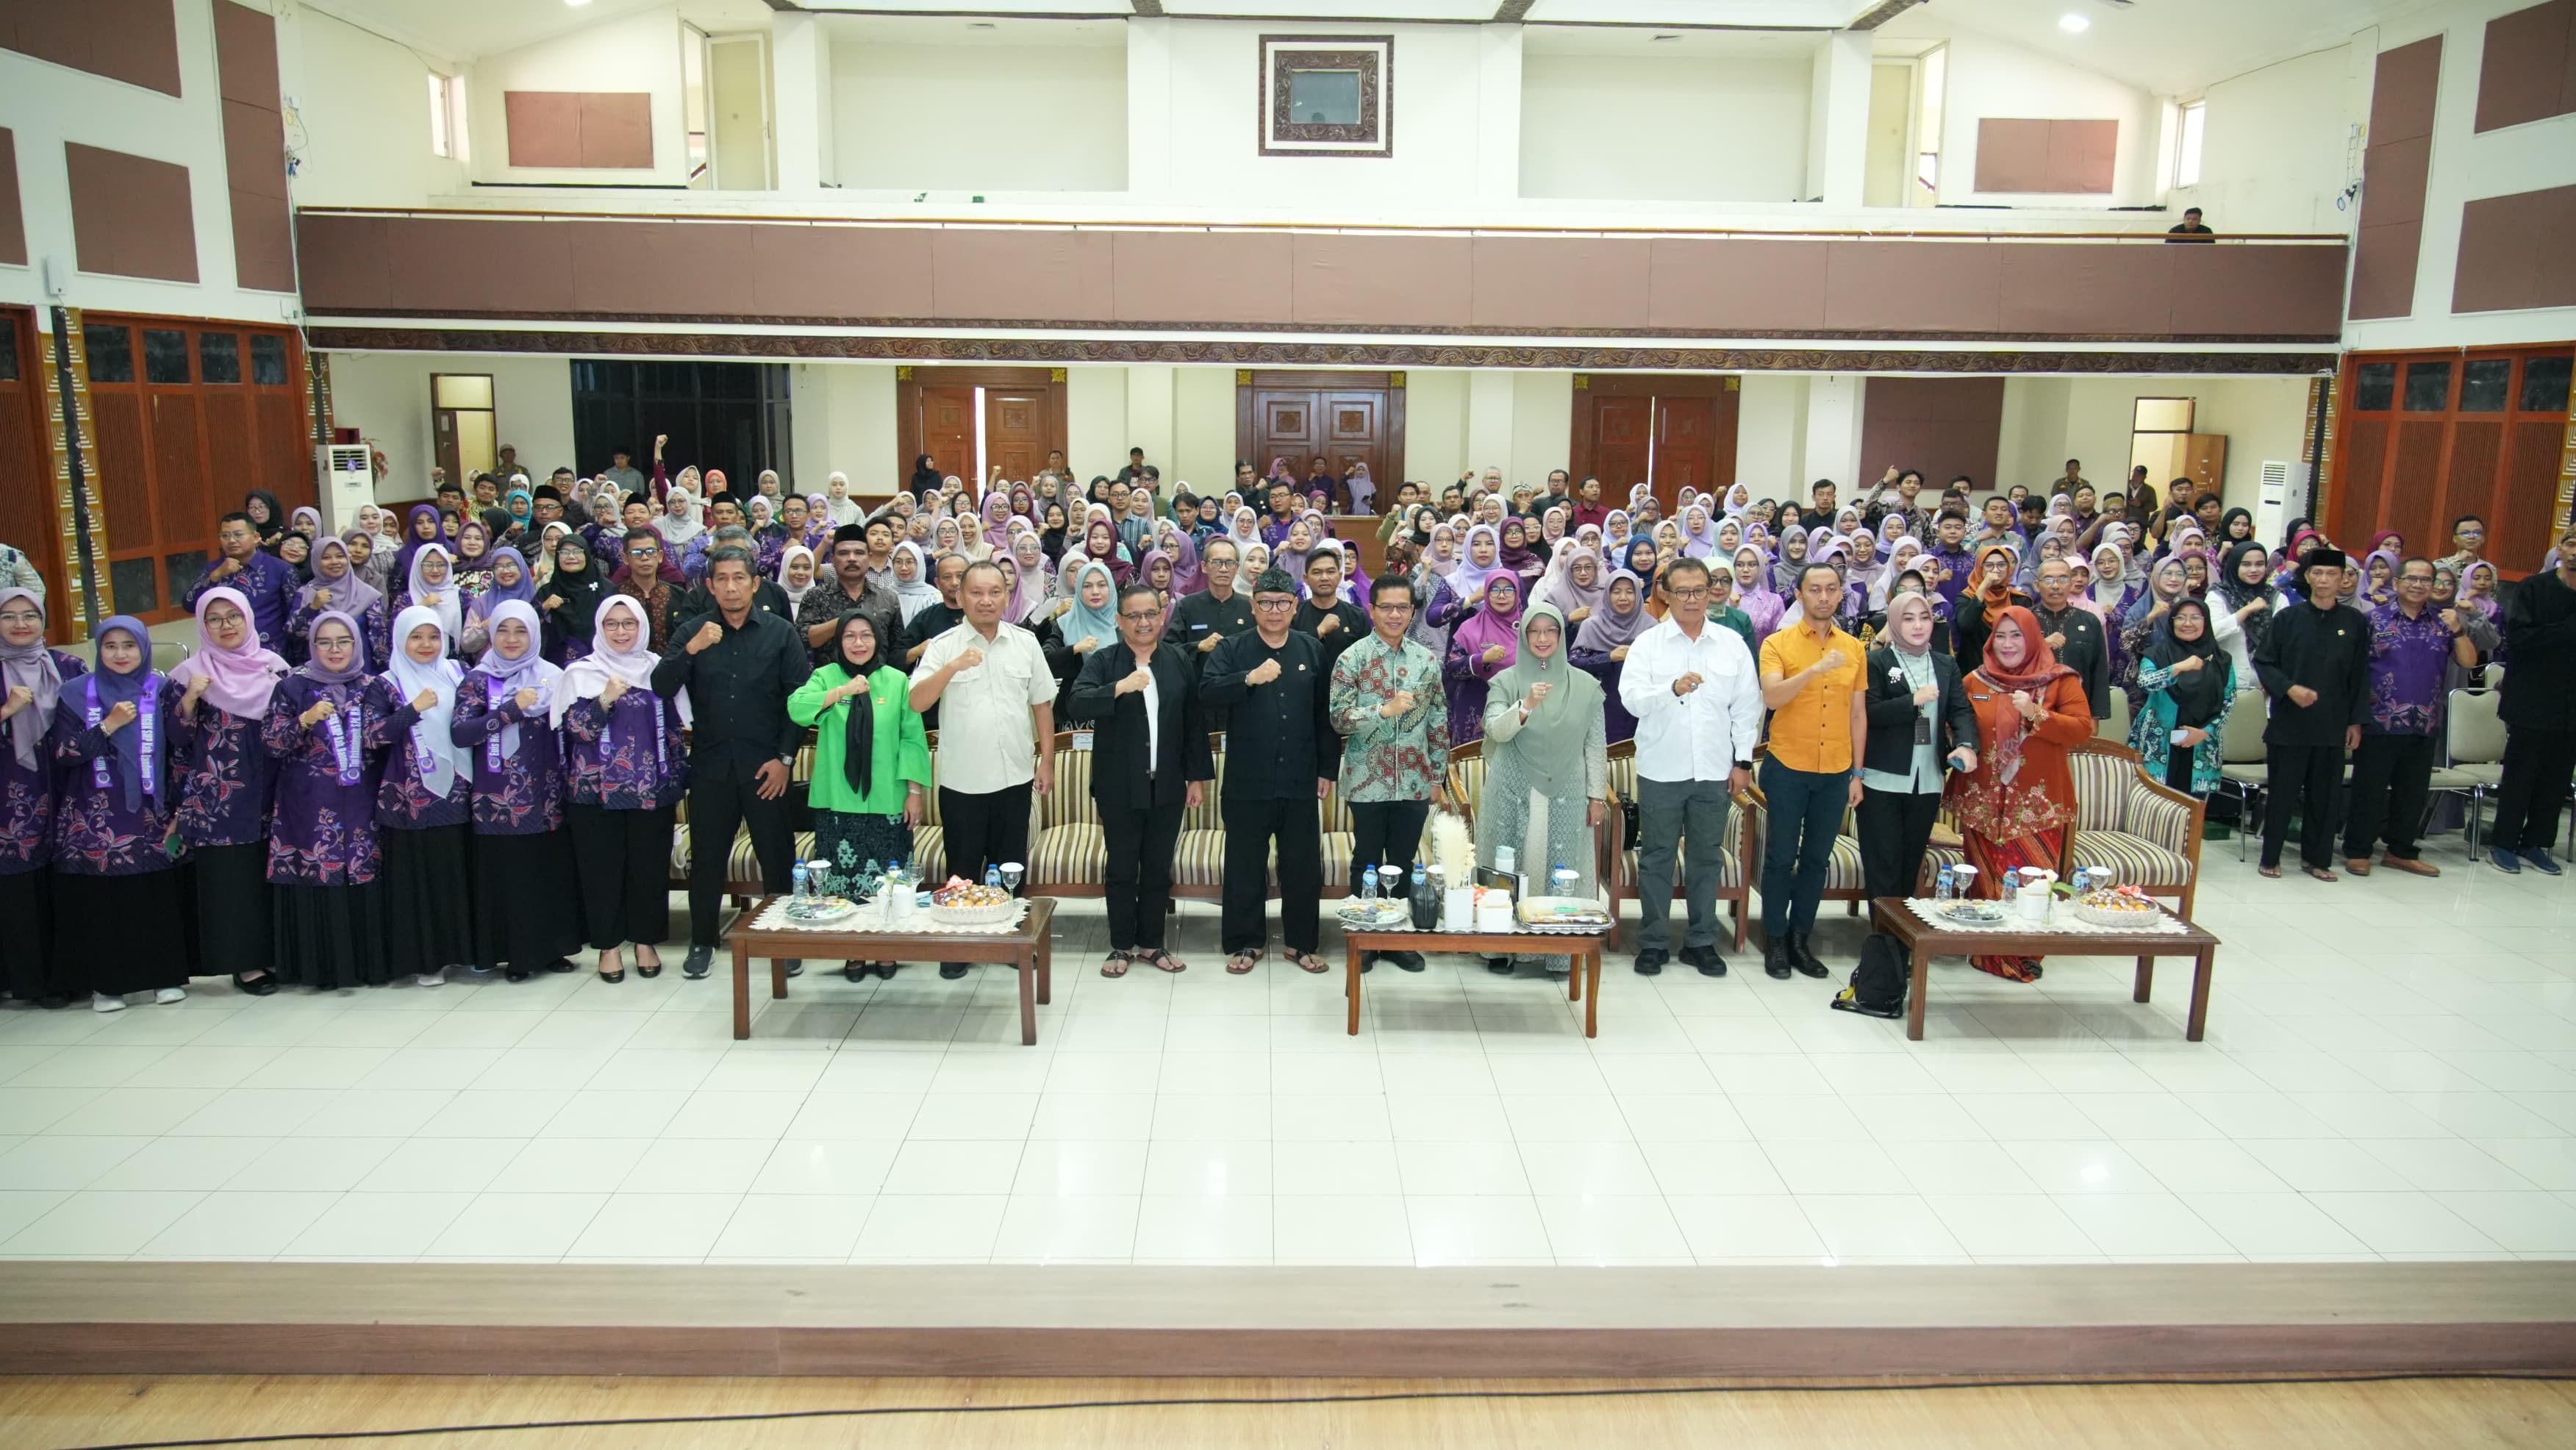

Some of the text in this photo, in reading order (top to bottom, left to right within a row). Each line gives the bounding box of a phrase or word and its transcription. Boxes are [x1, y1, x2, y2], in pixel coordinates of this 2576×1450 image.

[141, 713, 153, 729] MGBK
[656, 715, 665, 726] SMP
[141, 729, 153, 742] SMP
[331, 725, 343, 736] SMP
[337, 748, 348, 771] Bandung
[141, 754, 152, 779] Bandung
